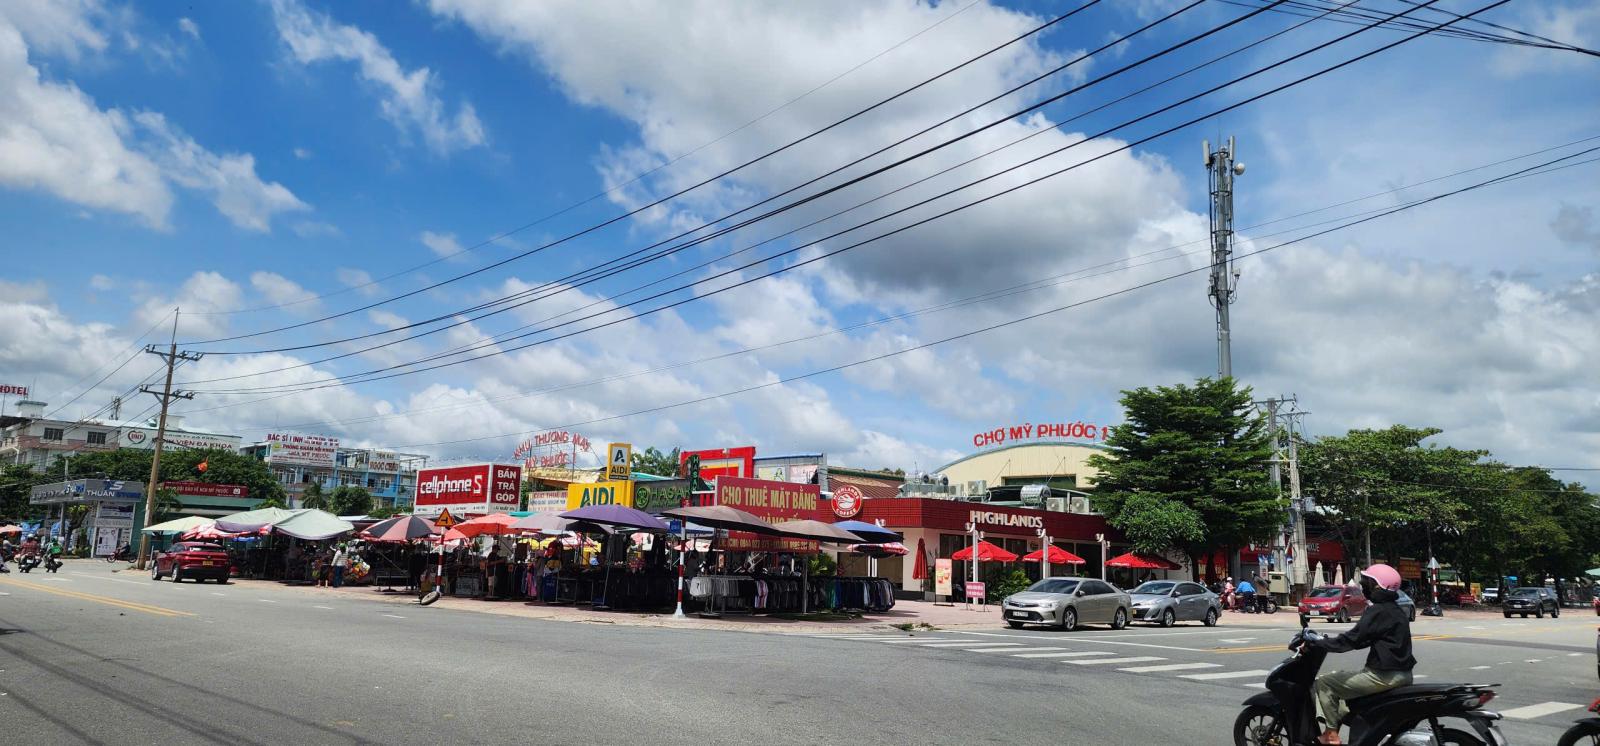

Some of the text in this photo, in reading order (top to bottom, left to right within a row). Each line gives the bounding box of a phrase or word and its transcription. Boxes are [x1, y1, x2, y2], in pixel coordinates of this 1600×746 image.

[973, 421, 1109, 447] CHỢ MỸ PHƯỚC 1
[497, 468, 517, 480] BÁN
[611, 466, 627, 475] AIDI
[496, 480, 515, 492] TRẢ
[495, 492, 515, 503] GÓP
[579, 487, 615, 508] AIDI
[721, 485, 817, 513] CHO THUÊ MẶT BẰNG
[833, 487, 860, 500] HIGHLANDS
[836, 507, 857, 516] COFFEE
[970, 510, 1043, 529] HIGHLANDS
